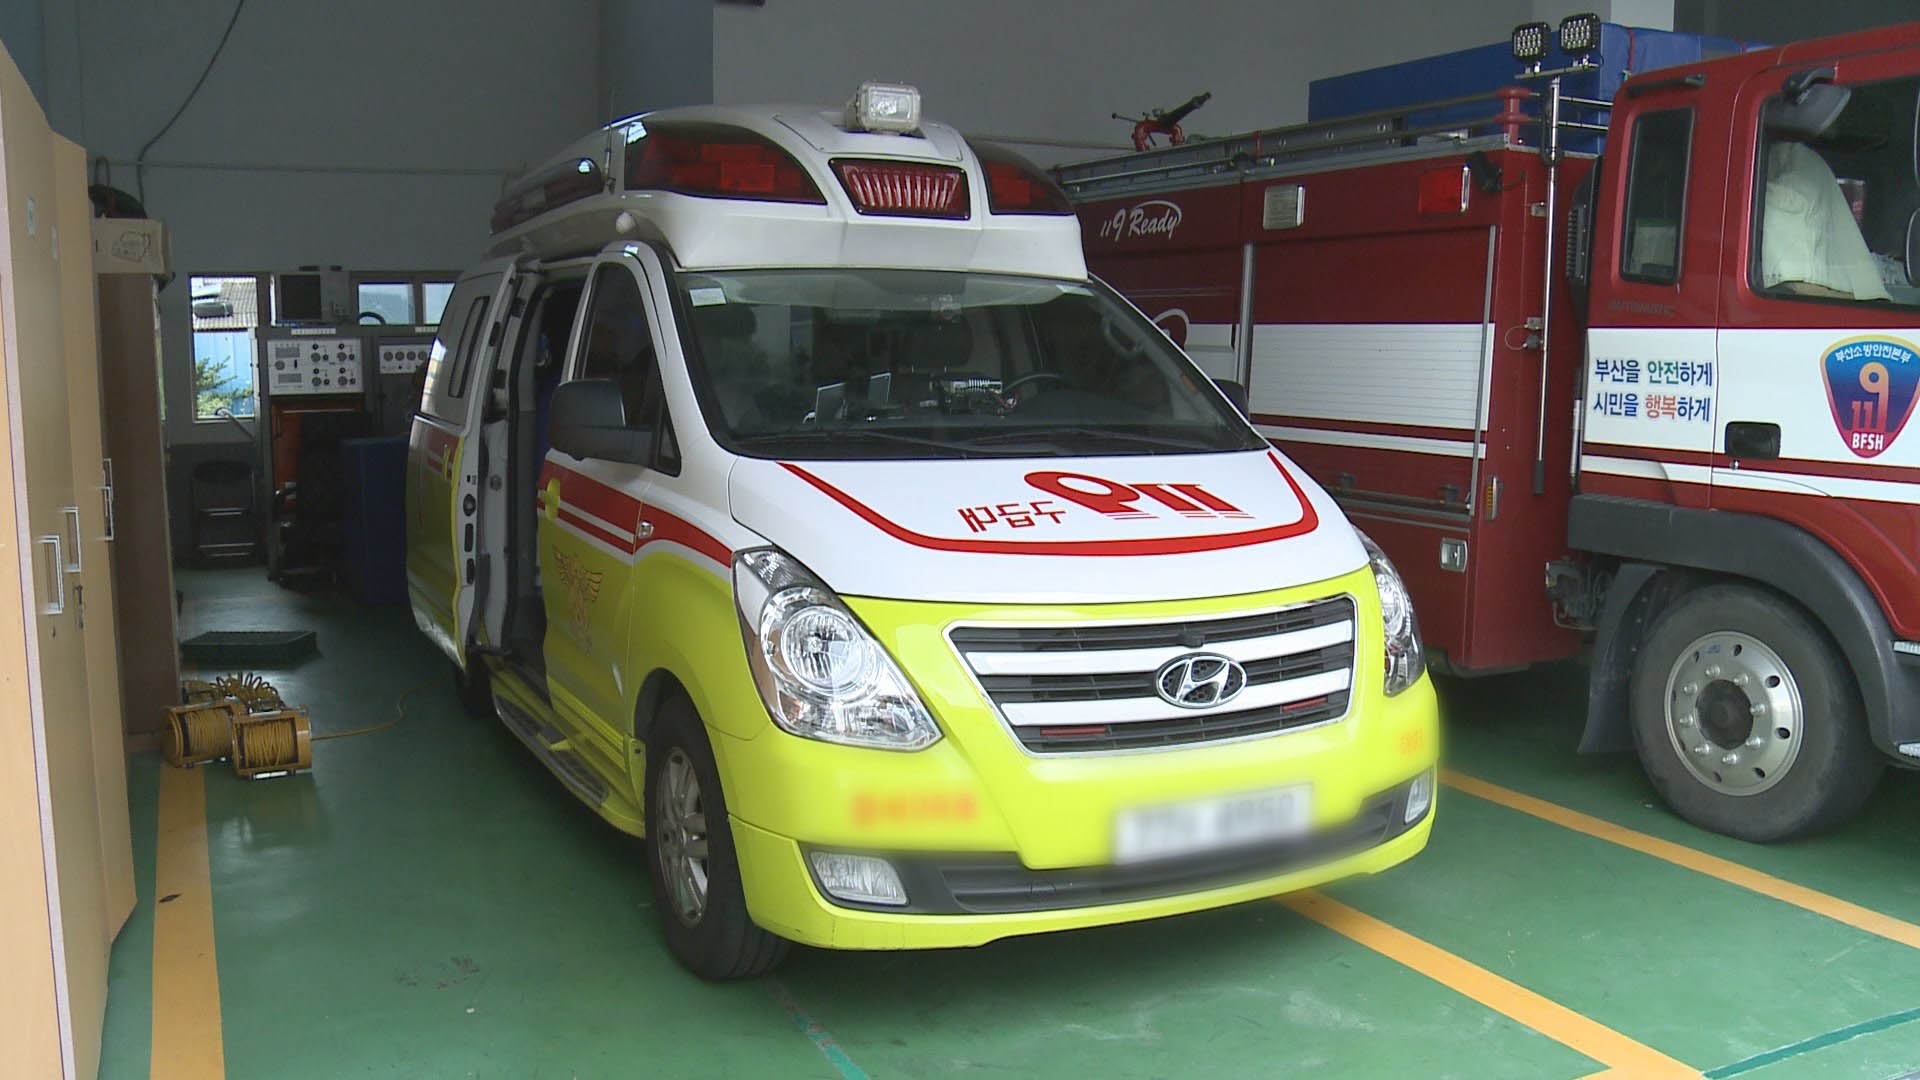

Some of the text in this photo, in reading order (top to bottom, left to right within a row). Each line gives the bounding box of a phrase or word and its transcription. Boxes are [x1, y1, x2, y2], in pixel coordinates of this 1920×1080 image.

[1100, 207, 1178, 242] 119 Ready
[1594, 359, 1713, 387] 부산을 안전하게
[1593, 391, 1711, 422] 시민을 행복하게
[1851, 361, 1890, 431] 119
[1851, 432, 1884, 451] BFSH
